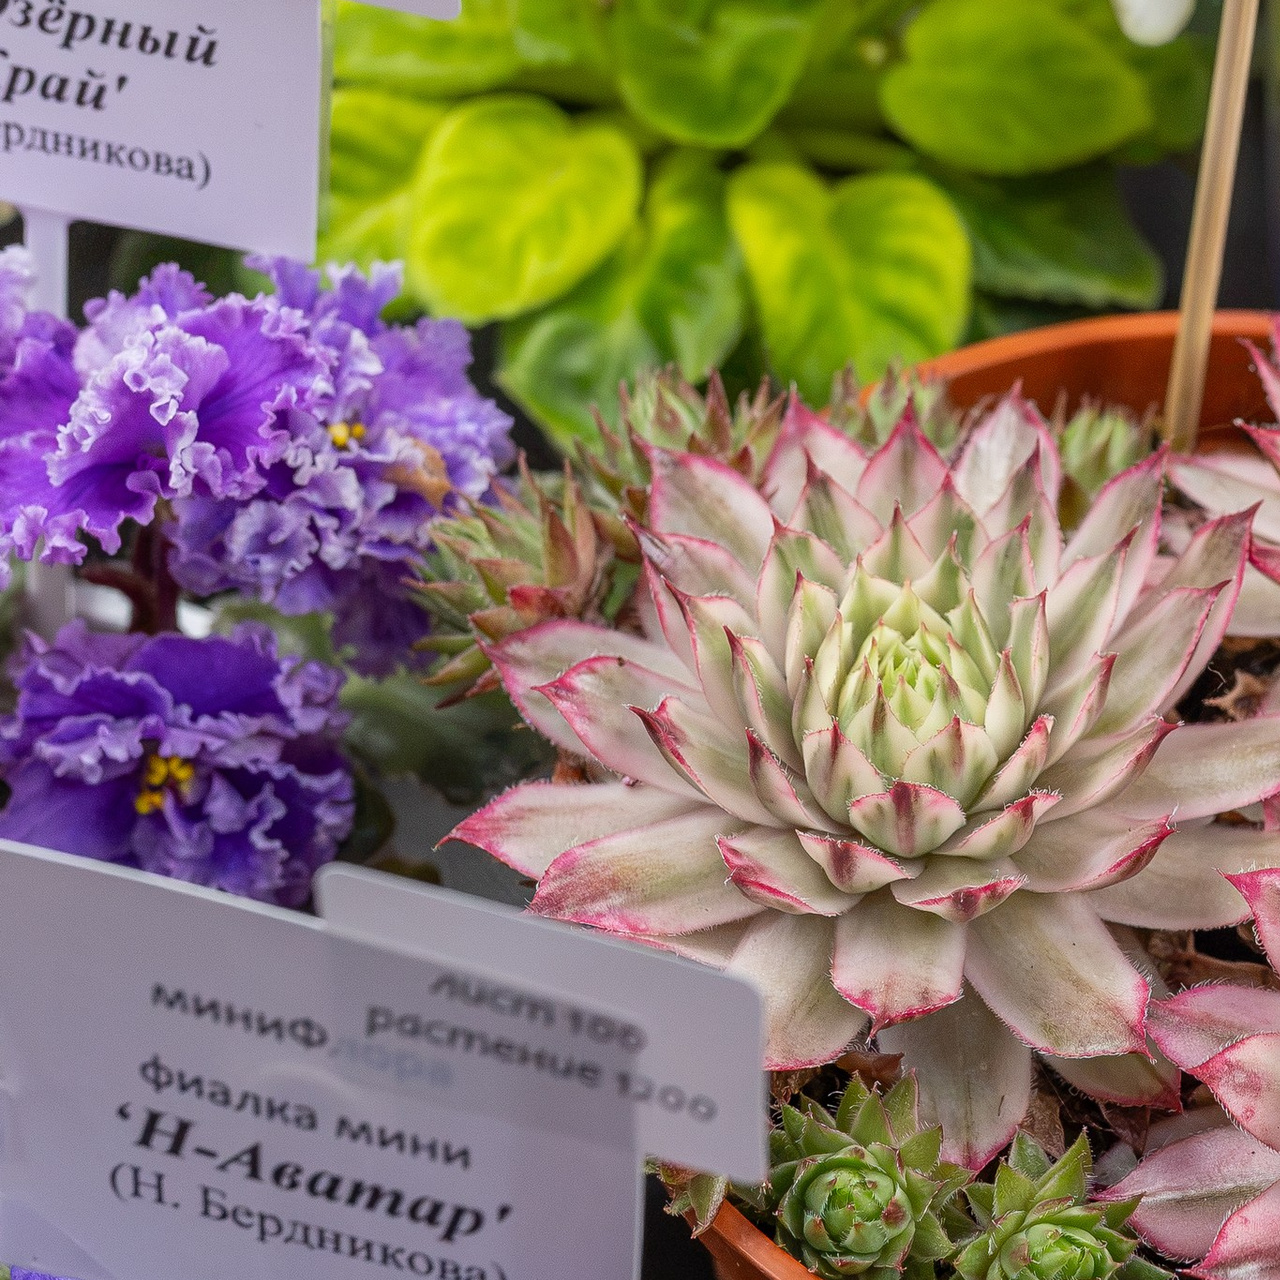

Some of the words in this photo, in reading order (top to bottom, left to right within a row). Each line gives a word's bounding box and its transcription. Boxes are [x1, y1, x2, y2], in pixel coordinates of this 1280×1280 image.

[0, 48, 128, 111] рай'
[365, 1003, 599, 1088] растение
[429, 971, 557, 1027] лист
[568, 1001, 647, 1054] 100
[139, 1054, 318, 1131] фиалка
[336, 1114, 472, 1170] мини
[109, 1162, 180, 1209] (Н.
